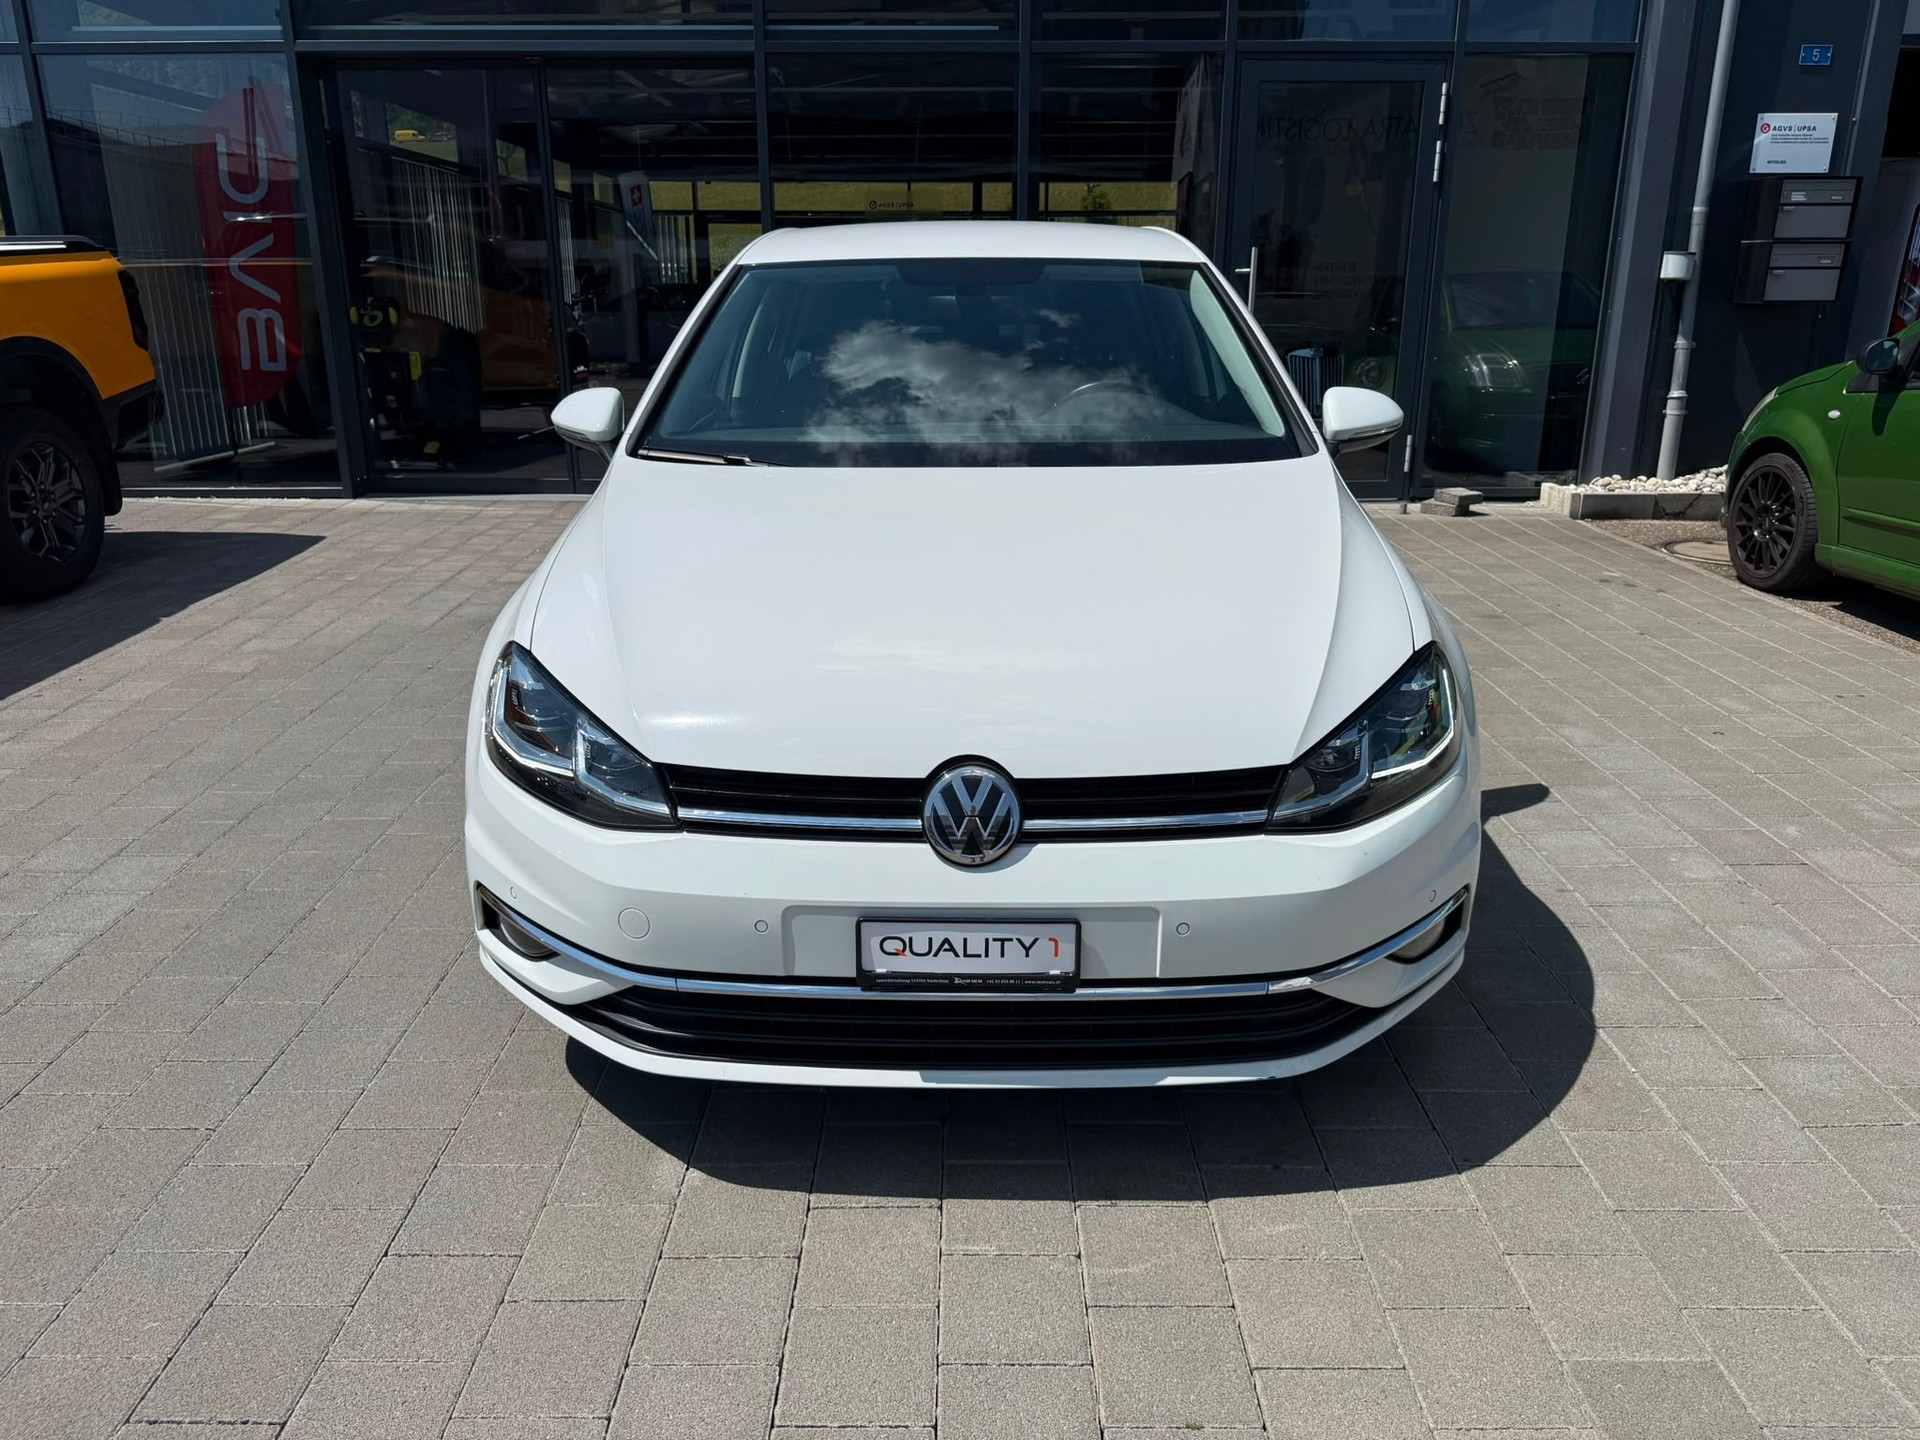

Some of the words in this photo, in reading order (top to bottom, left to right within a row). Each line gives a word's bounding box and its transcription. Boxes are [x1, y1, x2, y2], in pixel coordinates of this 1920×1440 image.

[1812, 48, 1821, 61] 5
[879, 935, 1040, 958] QUALITY
[1048, 936, 1059, 958] 1
